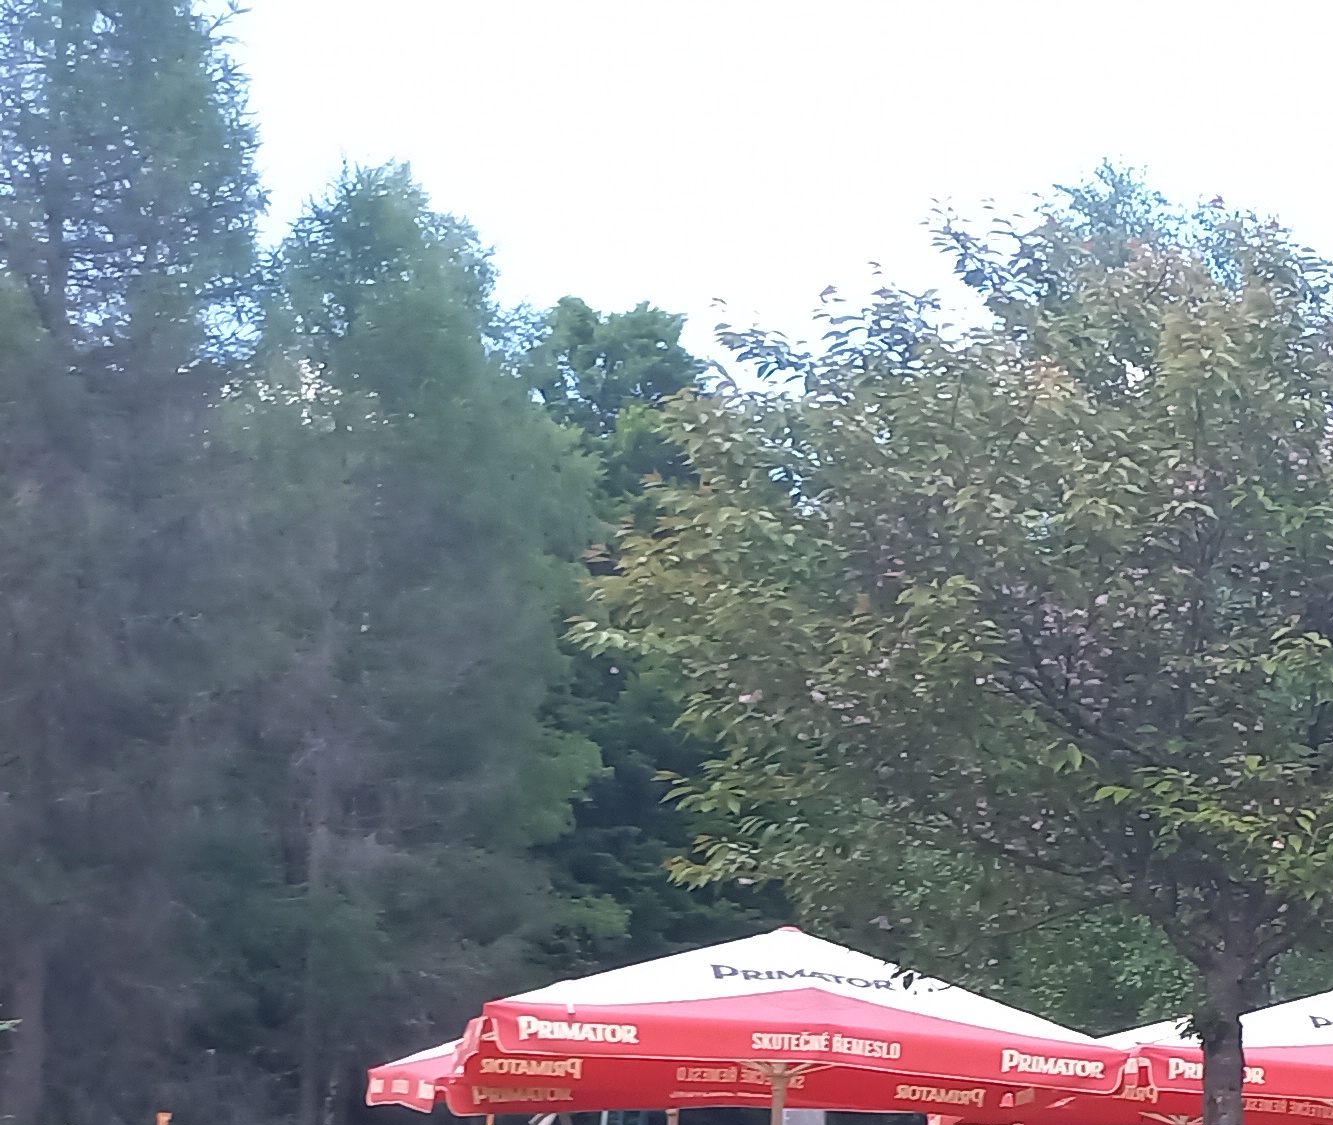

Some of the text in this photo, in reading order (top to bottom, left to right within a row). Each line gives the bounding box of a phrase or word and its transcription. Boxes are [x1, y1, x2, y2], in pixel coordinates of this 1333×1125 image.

[710, 963, 897, 991] PRIMATOR
[516, 1015, 640, 1044] PRIMATOR
[751, 1032, 901, 1060] SKUTEČNÉ ŘEMESLO
[1001, 1048, 1106, 1080] PRIMATOR
